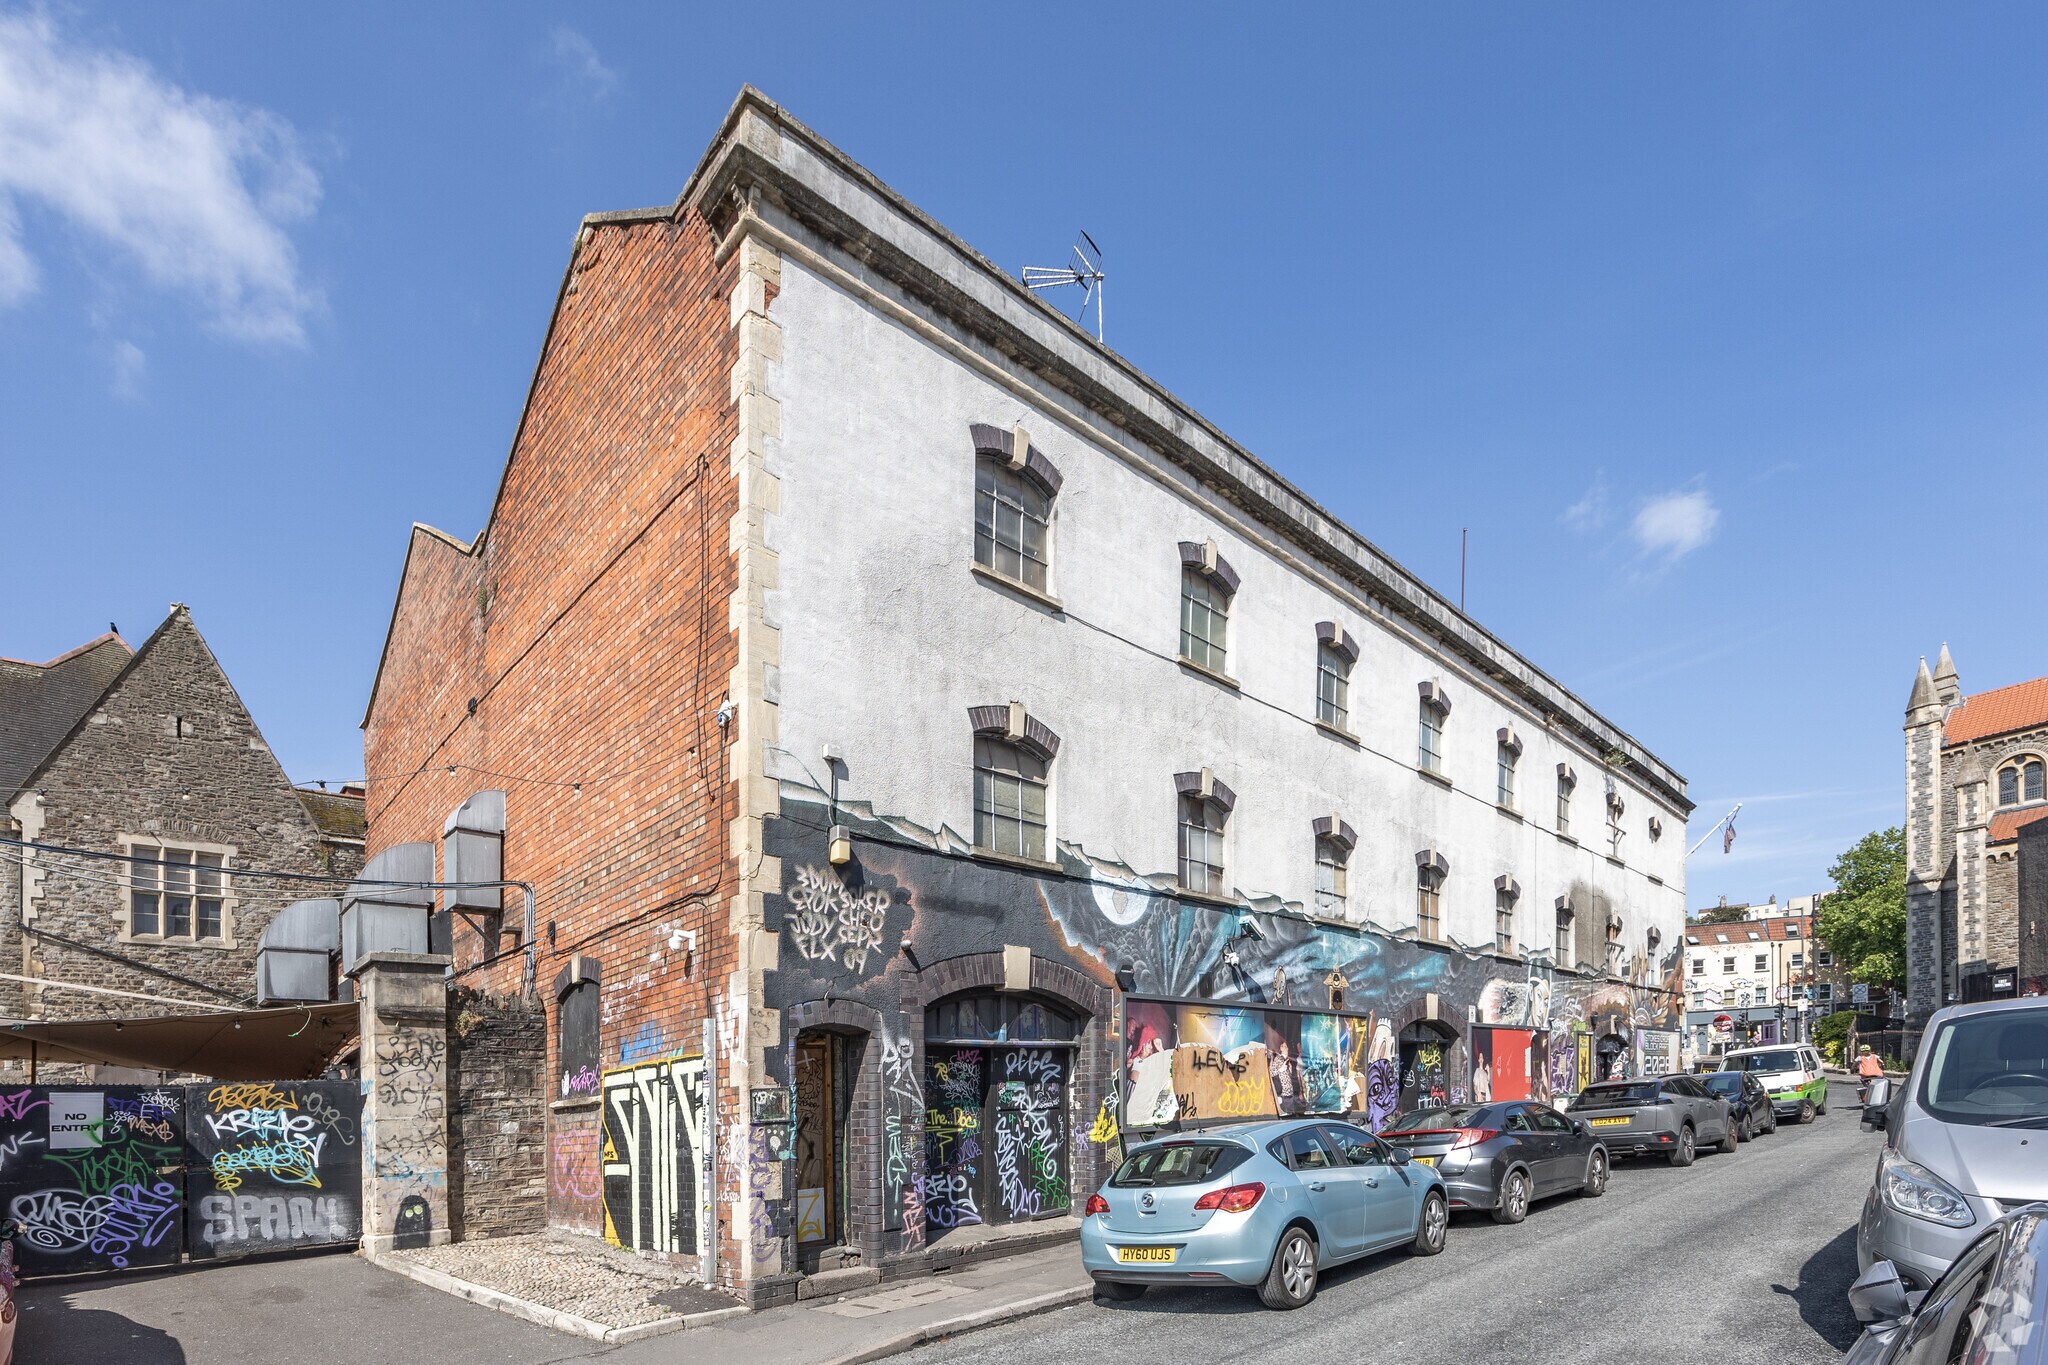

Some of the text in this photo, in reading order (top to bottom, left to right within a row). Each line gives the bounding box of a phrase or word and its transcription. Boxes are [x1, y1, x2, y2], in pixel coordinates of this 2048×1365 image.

[51, 1124, 99, 1132] ENTRY
[1123, 1249, 1171, 1260] HY60 UJS
